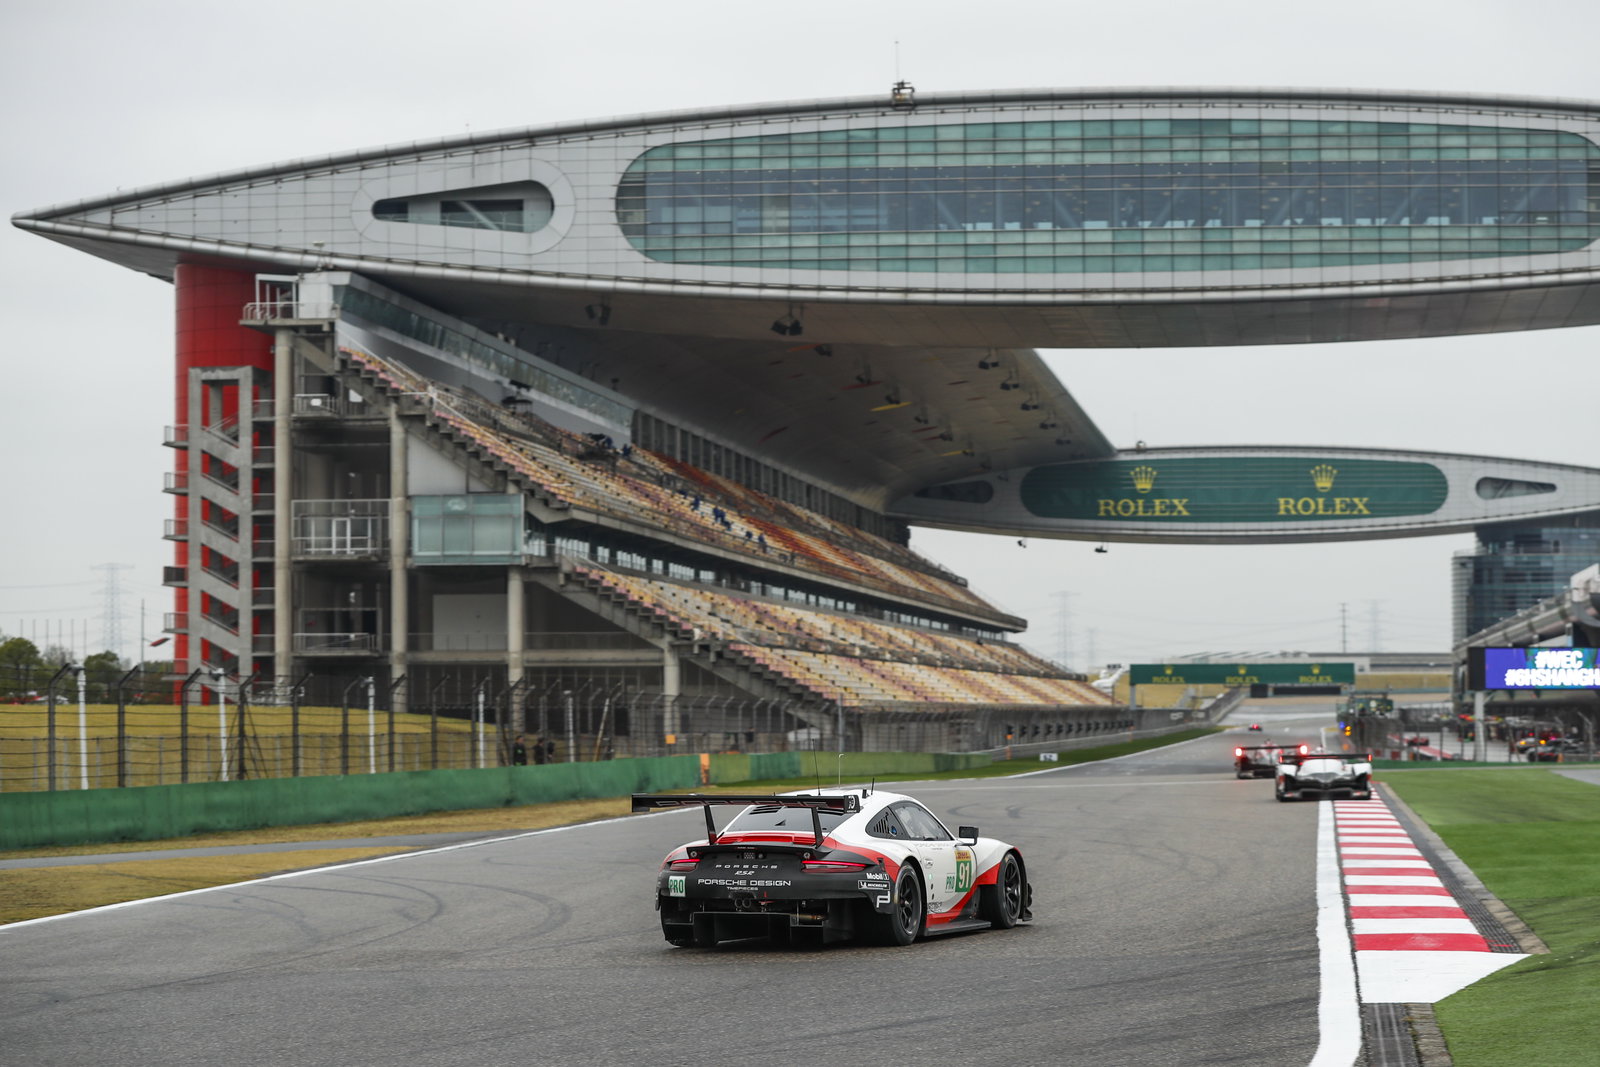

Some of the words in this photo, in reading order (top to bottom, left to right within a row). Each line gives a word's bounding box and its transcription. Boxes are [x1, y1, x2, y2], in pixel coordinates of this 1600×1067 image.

[1098, 499, 1191, 516] ROLEX
[1277, 497, 1371, 515] ROLEX
[1534, 650, 1584, 669] #WEC
[1152, 676, 1185, 684] ROLEX
[1225, 676, 1259, 684] ROLEX
[1299, 675, 1333, 683] ROLEX
[866, 872, 884, 880] Mobil
[958, 862, 970, 889] 91
[669, 879, 684, 894] PRO
[697, 878, 747, 886] PORSCHE
